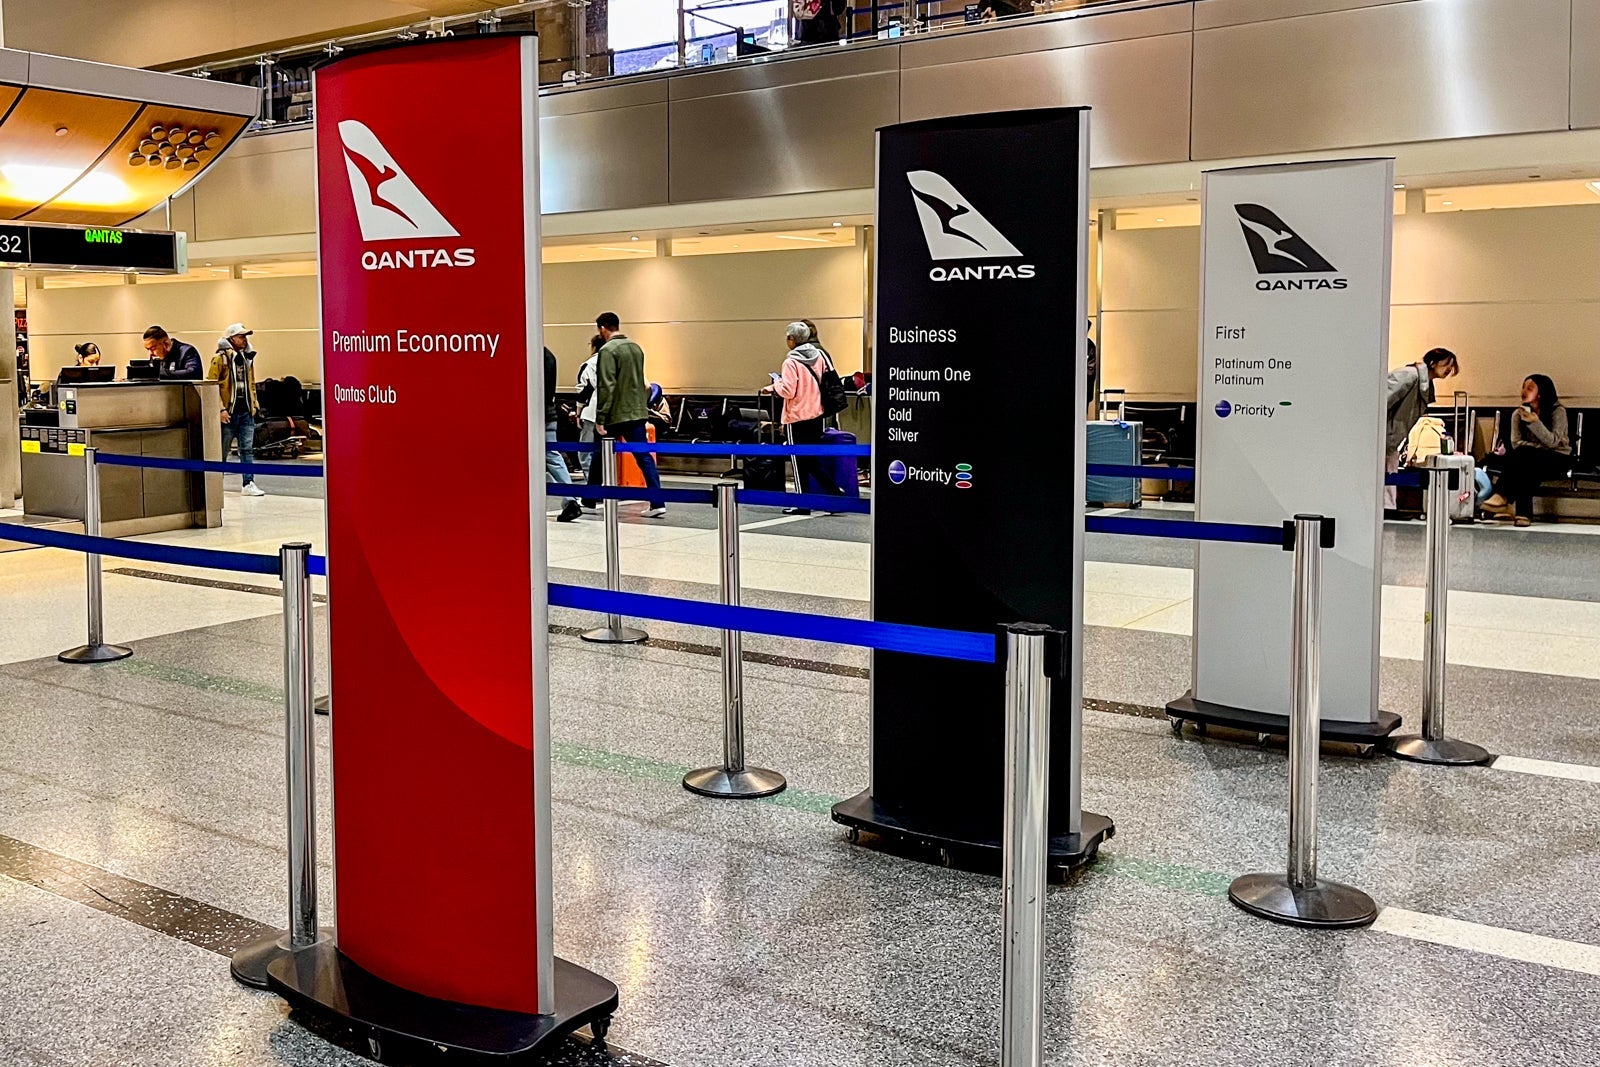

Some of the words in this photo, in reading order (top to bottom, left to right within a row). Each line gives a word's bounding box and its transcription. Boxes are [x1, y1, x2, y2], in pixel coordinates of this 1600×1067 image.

[0, 235, 22, 253] 32
[85, 230, 122, 243] QANTAS
[361, 247, 476, 270] QANTAS
[929, 264, 1036, 281] QANTAS
[1256, 278, 1348, 291] QANTAS
[889, 326, 957, 343] Business
[1215, 325, 1246, 340] First
[332, 329, 391, 352] Premium
[397, 329, 500, 358] Economy
[1215, 358, 1264, 369] Platinum
[1267, 358, 1292, 370] One
[889, 367, 941, 381] Platinum
[944, 367, 972, 382] One
[1214, 374, 1264, 386] Platinum
[334, 384, 365, 404] Qantas
[368, 385, 397, 404] Club
[889, 387, 941, 402] Platinum
[888, 407, 912, 422] Gold
[1234, 404, 1275, 418] Priority
[888, 427, 919, 442] Silver
[908, 466, 952, 485] Priority
